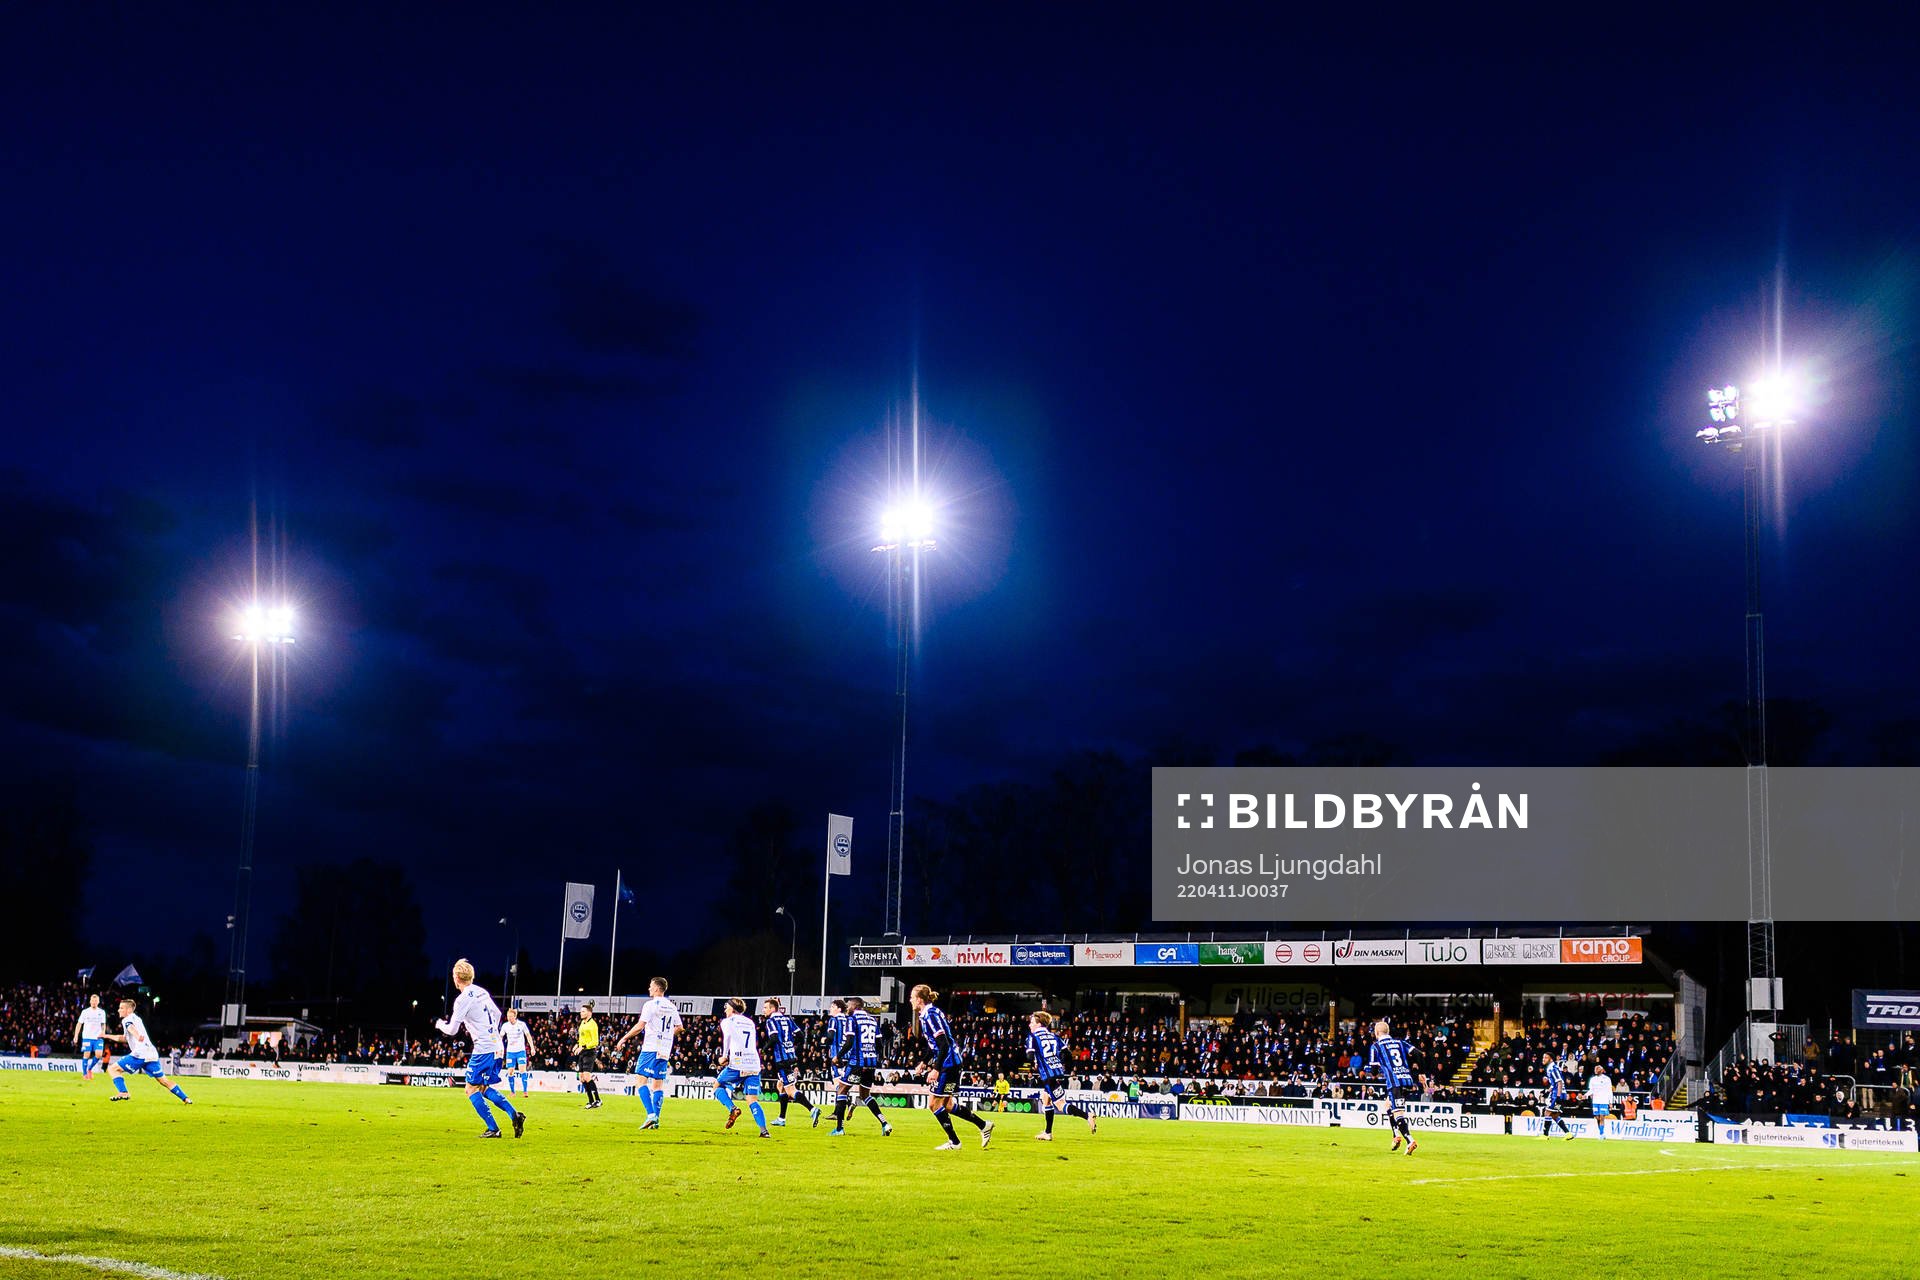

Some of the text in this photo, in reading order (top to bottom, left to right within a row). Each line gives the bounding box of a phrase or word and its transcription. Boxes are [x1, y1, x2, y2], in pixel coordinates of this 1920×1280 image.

[1029, 950, 1042, 958] Best
[1371, 949, 1405, 957] MASKIN
[1572, 940, 1630, 955] ramo
[853, 952, 898, 960] FORMENTA
[1867, 1004, 1920, 1016] TRO
[742, 1030, 751, 1049] 7
[860, 1024, 877, 1044] 26
[1041, 1039, 1058, 1058] 27
[1390, 1048, 1403, 1067] 3
[411, 1076, 451, 1088] RIMEDA
[1185, 1106, 1249, 1122] NOMINIT
[1258, 1108, 1325, 1125] NOMINIT
[1460, 1115, 1477, 1129] Bil
[1611, 1121, 1675, 1141] Windings
[1753, 1133, 1805, 1144] gjuteriteknik
[1851, 1137, 1904, 1147] gjuteriteknik
